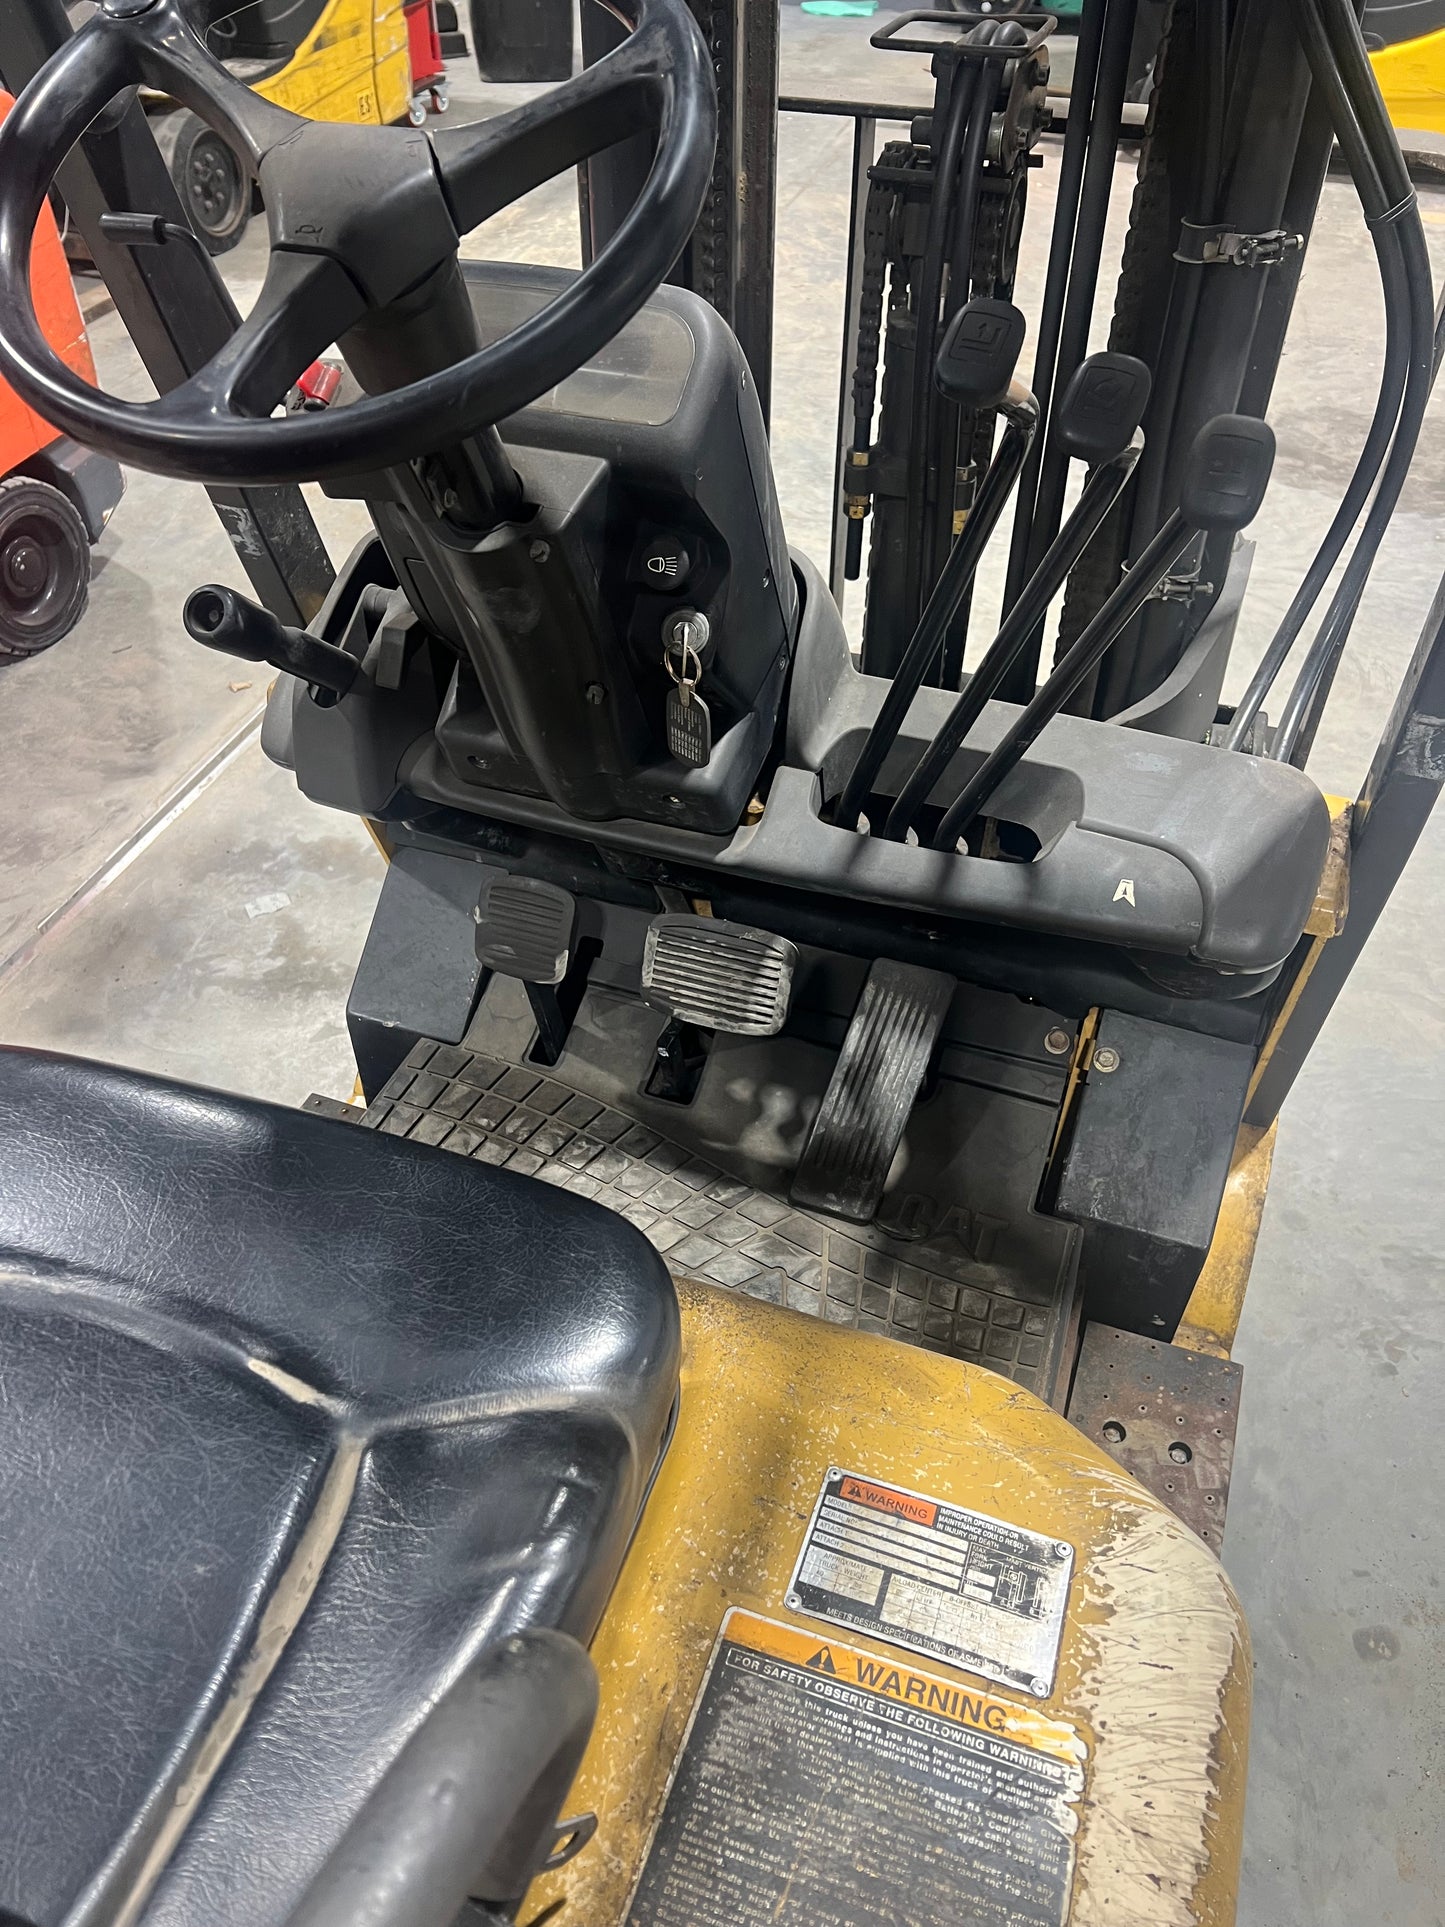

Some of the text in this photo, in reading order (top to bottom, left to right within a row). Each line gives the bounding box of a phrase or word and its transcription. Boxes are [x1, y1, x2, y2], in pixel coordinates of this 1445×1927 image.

[897, 1194, 1010, 1262] CAT
[864, 1490, 928, 1519] WARNING
[814, 1533, 840, 1547] ATTACH
[818, 1520, 844, 1534] ATTACH
[935, 1521, 999, 1549] IN INJURY OR DEATH
[937, 1514, 1029, 1552] MAINTENANCE COULD RESULT
[939, 1507, 1019, 1540] IMPROPER OPERATION OR
[825, 1605, 854, 1622] MEETS
[852, 1615, 884, 1633] DESIGN
[734, 1653, 760, 1670] FOR
[762, 1663, 811, 1689] SAFETY
[813, 1681, 875, 1711] OBSERVE
[877, 1703, 904, 1722] THE
[906, 1713, 986, 1751] FOLLOWING
[855, 1658, 1006, 1731] WARNING
[766, 1687, 800, 1705] operate
[804, 1698, 822, 1712] this
[825, 1705, 849, 1723] truck
[851, 1716, 882, 1736] unless
[885, 1729, 903, 1744] you
[906, 1735, 929, 1752] have
[958, 1753, 992, 1774] trained
[995, 1767, 1014, 1782] and
[772, 1698, 795, 1714] Read
[854, 1727, 873, 1742] and
[995, 1778, 1031, 1800] manual
[799, 1729, 835, 1750] dealers.
[795, 1738, 814, 1753] this
[818, 1746, 843, 1763] truck
[873, 1767, 890, 1781] you
[895, 1773, 918, 1790] have
[921, 1784, 963, 1806] checked
[1040, 1827, 1063, 1844] Give
[931, 1765, 951, 1781] this
[953, 1773, 978, 1791] truck
[981, 1784, 992, 1796] or
[996, 1789, 1040, 1813] available
[692, 1800, 708, 1814] use
[677, 1840, 726, 1868] backward.
[987, 1819, 1041, 1847] Controller,
[1043, 1839, 1063, 1855] Lift
[674, 1851, 688, 1865] Do
[690, 1858, 707, 1872] not
[710, 1865, 743, 1887] handle
[972, 1858, 1002, 1878] Never
[1035, 1884, 1054, 1899] any
[1005, 1848, 1036, 1868] hoses
[1039, 1860, 1058, 1876] and
[663, 1883, 678, 1898] Do
